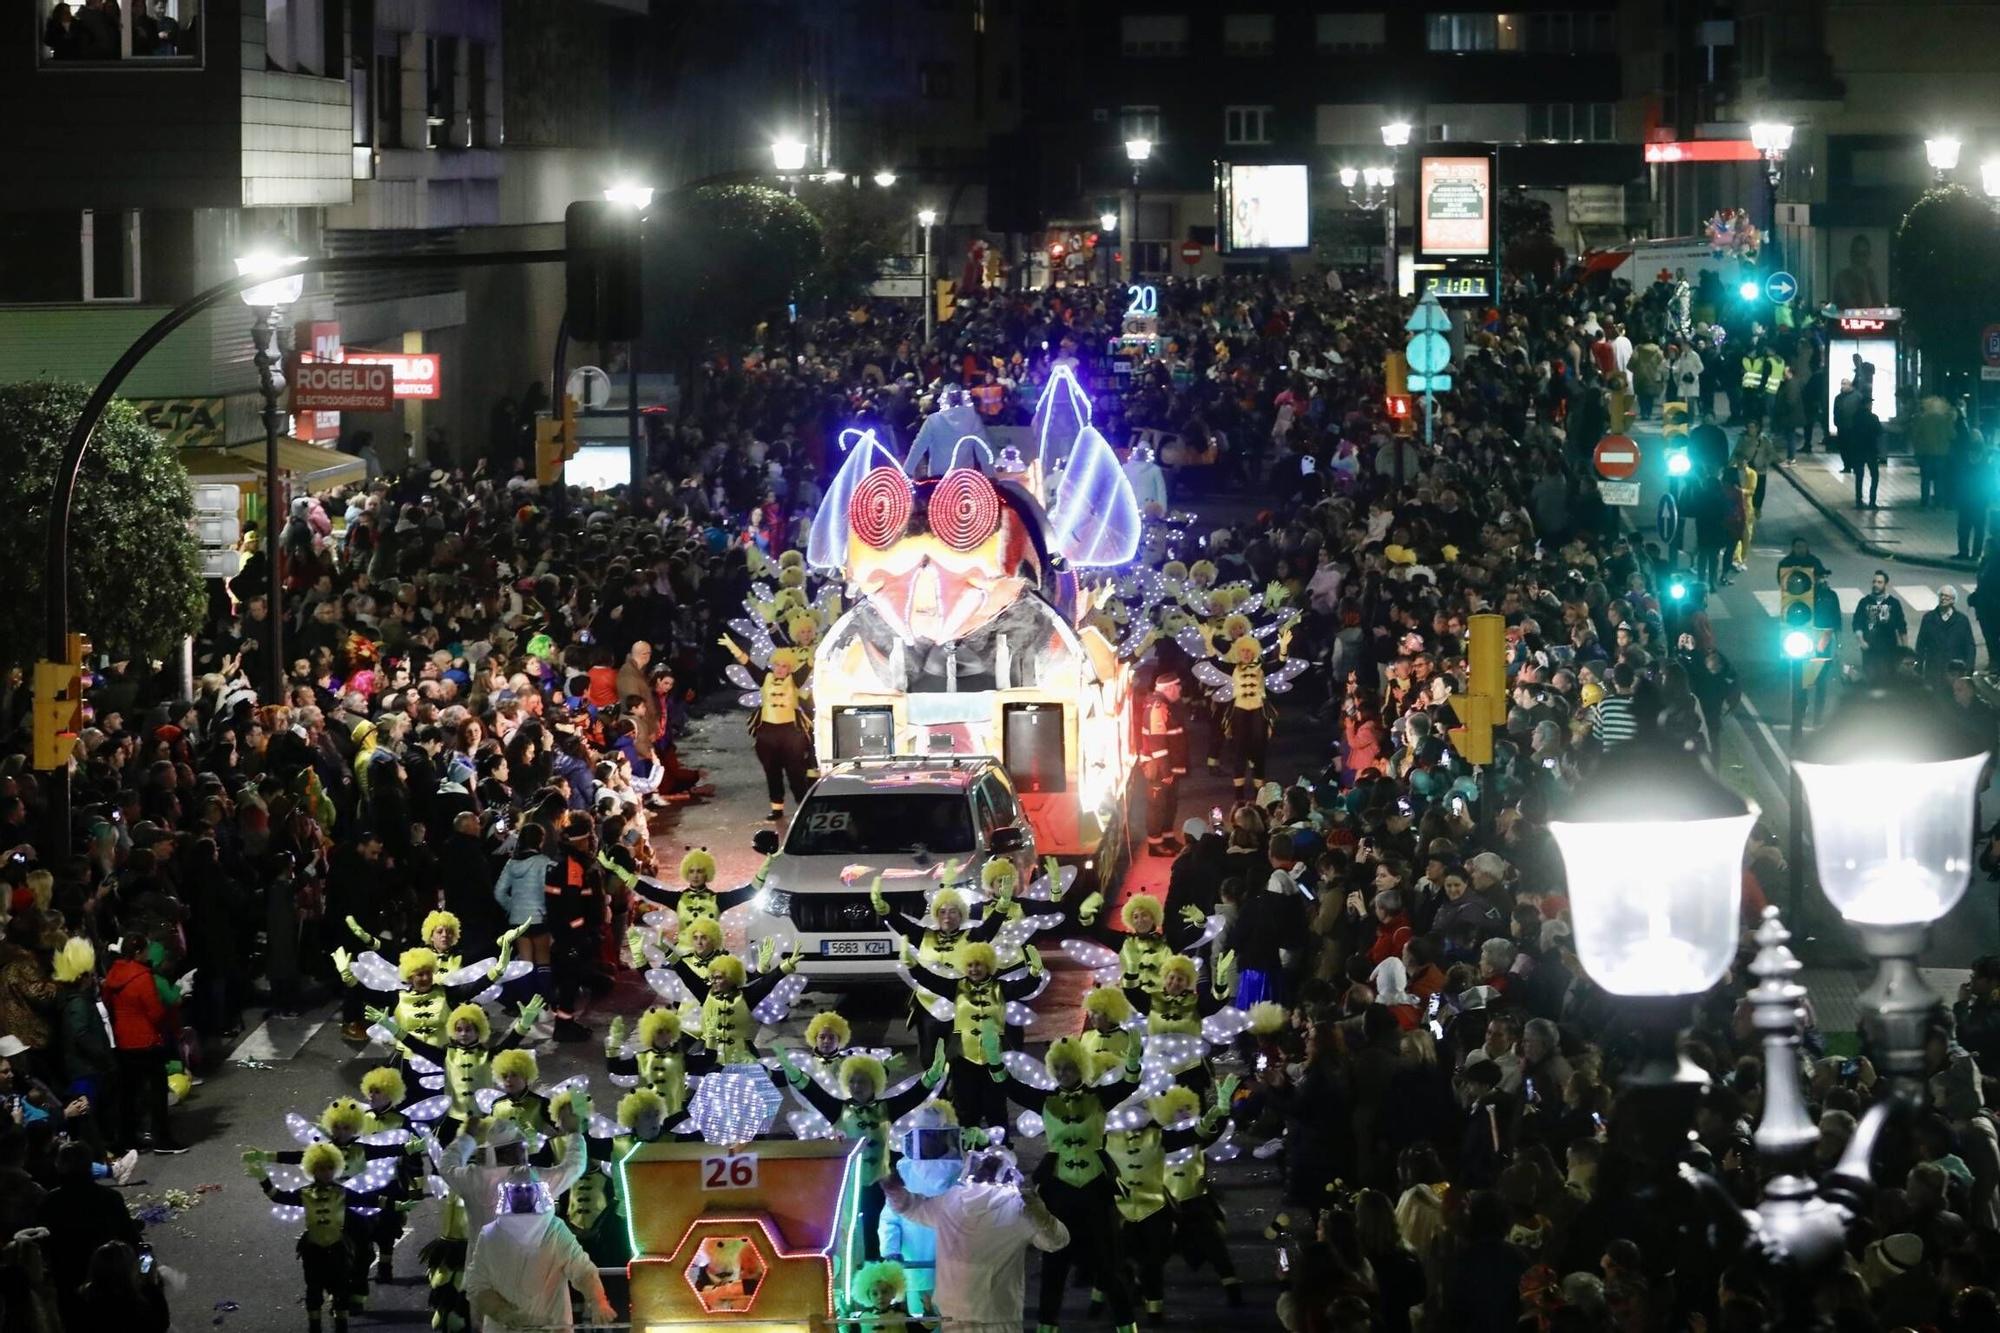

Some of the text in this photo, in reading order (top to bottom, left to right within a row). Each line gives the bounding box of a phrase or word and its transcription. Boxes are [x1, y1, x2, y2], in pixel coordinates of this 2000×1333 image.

[1427, 278, 1486, 294] 21:07
[1127, 285, 1157, 313] 20
[296, 368, 386, 391] ROGELIO
[296, 394, 386, 406] ELECTRODOMÉSTICOS
[142, 403, 216, 432] ETA
[811, 814, 845, 830] 26
[831, 942, 885, 954] 5663 KZH
[705, 1156, 753, 1187] 26
